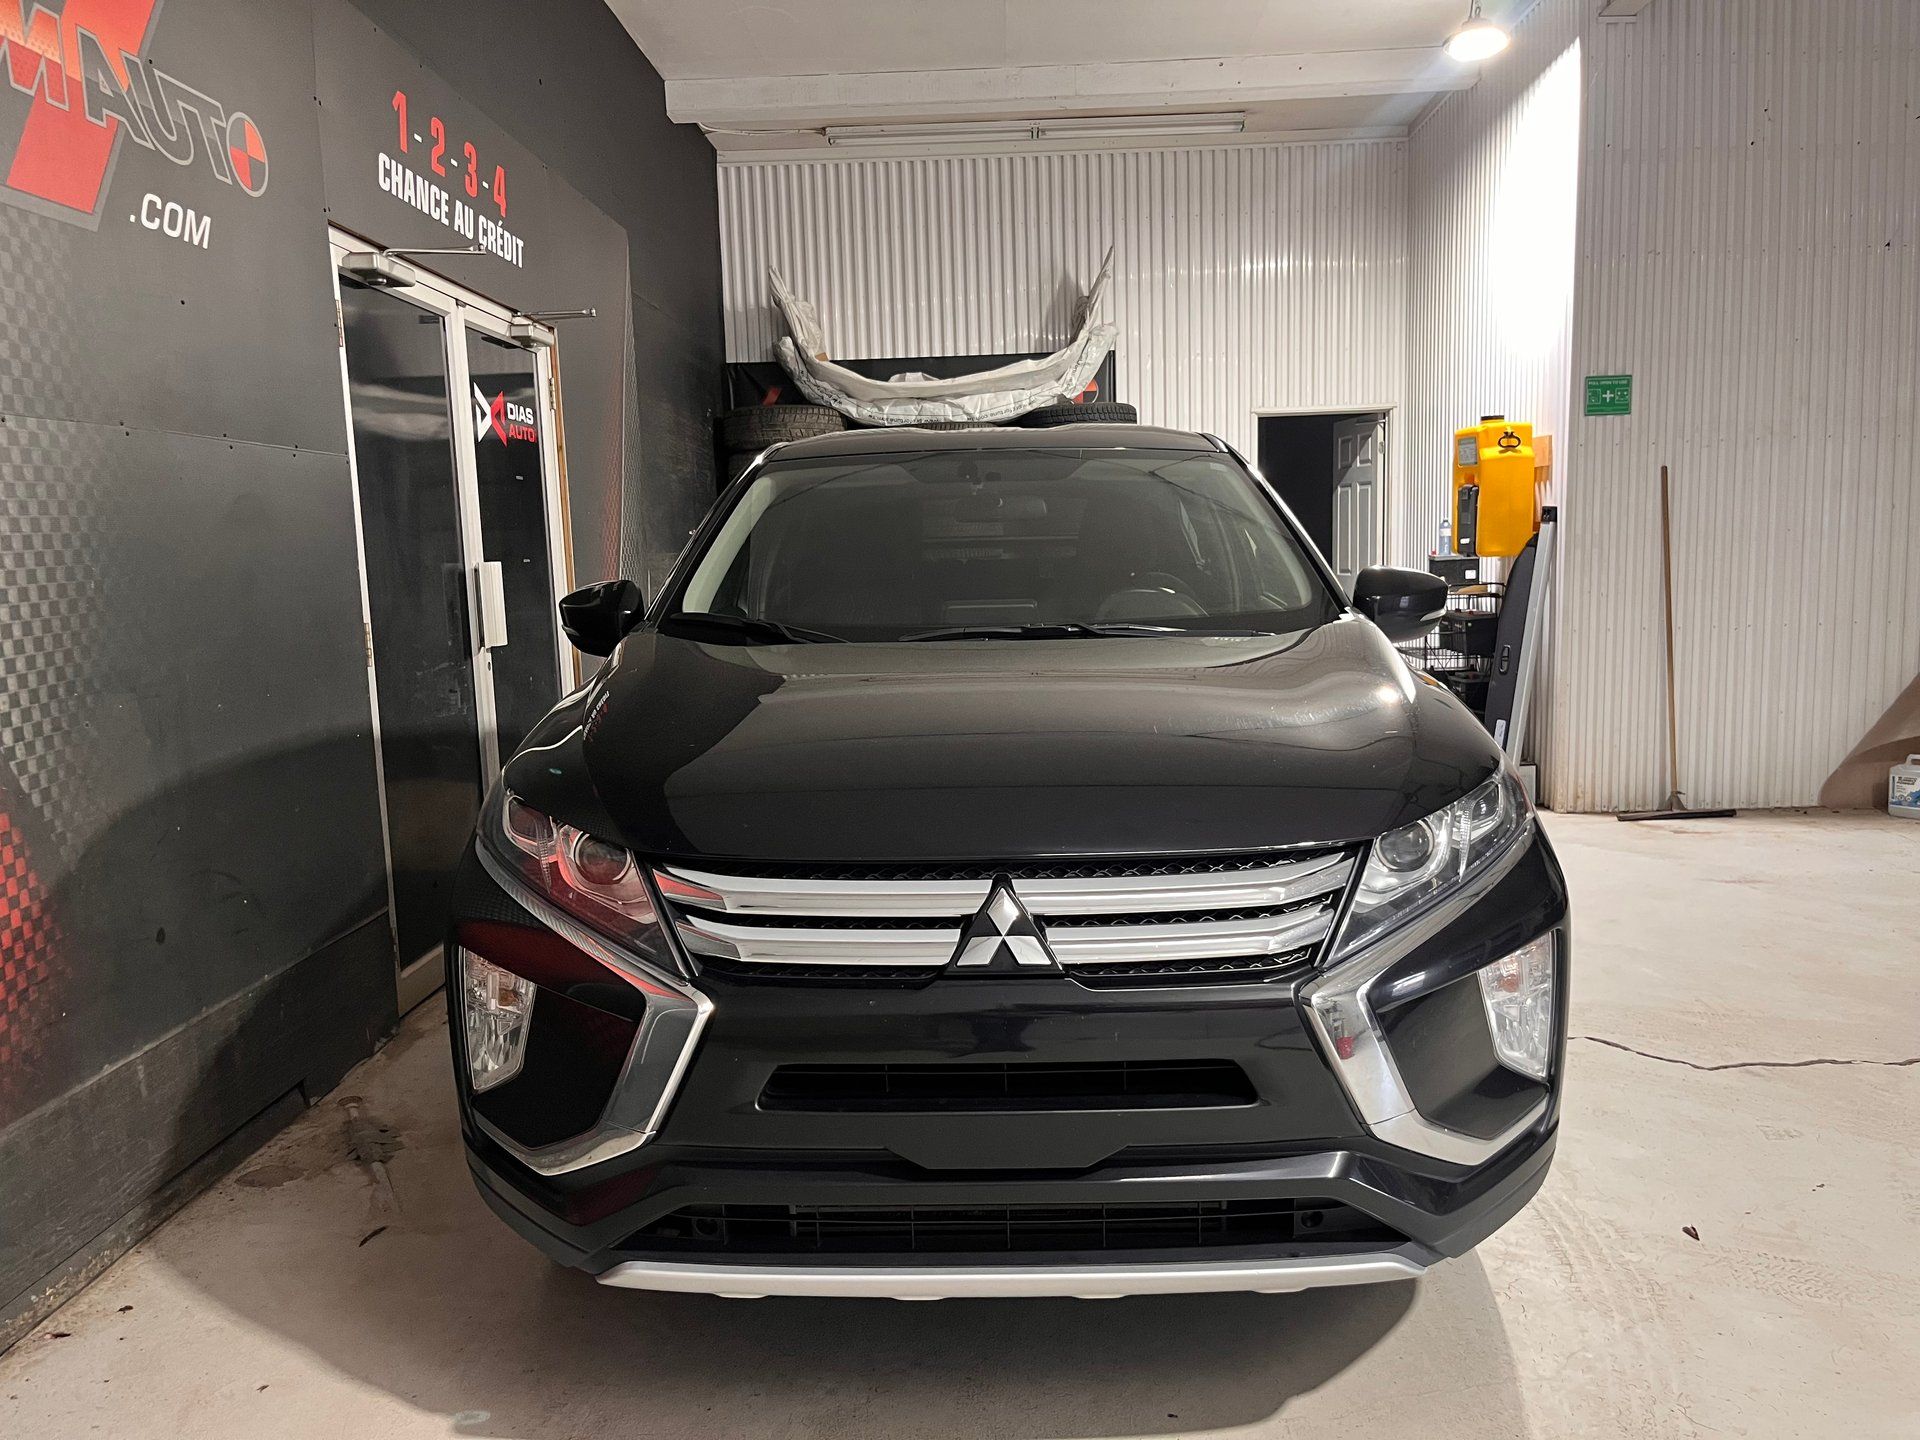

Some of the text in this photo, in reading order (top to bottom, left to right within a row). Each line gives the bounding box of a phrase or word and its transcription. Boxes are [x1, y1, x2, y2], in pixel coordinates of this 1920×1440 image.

[129, 193, 212, 250] .COM
[378, 152, 524, 268] CHANCE AU CRÉDIT
[506, 402, 534, 425] DIAS
[508, 423, 537, 443] AUTO
